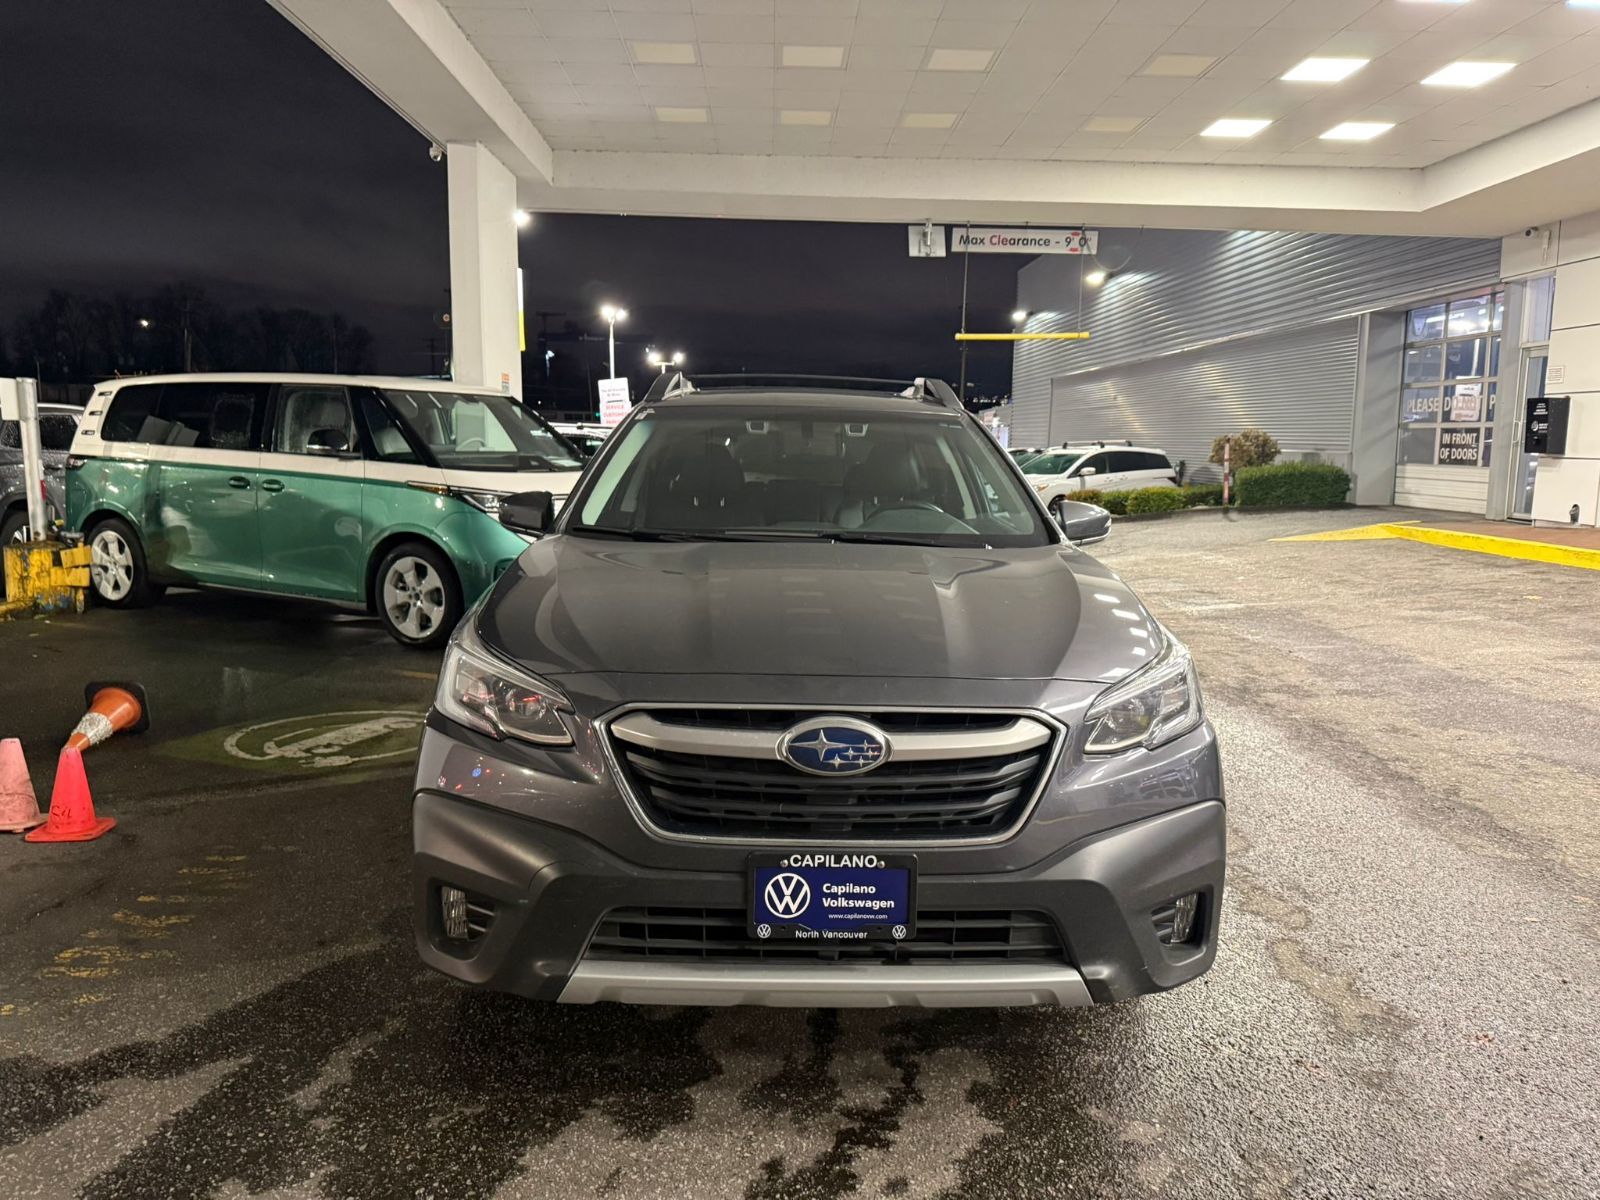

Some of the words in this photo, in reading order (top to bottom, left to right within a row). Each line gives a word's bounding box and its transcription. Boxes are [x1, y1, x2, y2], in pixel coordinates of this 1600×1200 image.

[959, 235, 985, 245] Max
[989, 234, 1051, 247] Clearance
[1407, 397, 1440, 413] PLEASE
[1442, 432, 1451, 444] IN
[1452, 433, 1478, 445] FRONT
[1440, 448, 1450, 459] OF
[1451, 448, 1478, 460] DOORS
[789, 854, 878, 868] CAPILANO
[822, 883, 876, 896] Capilano
[822, 897, 895, 910] Volkswagen
[795, 930, 819, 939] North
[822, 930, 868, 939] Vancouver
